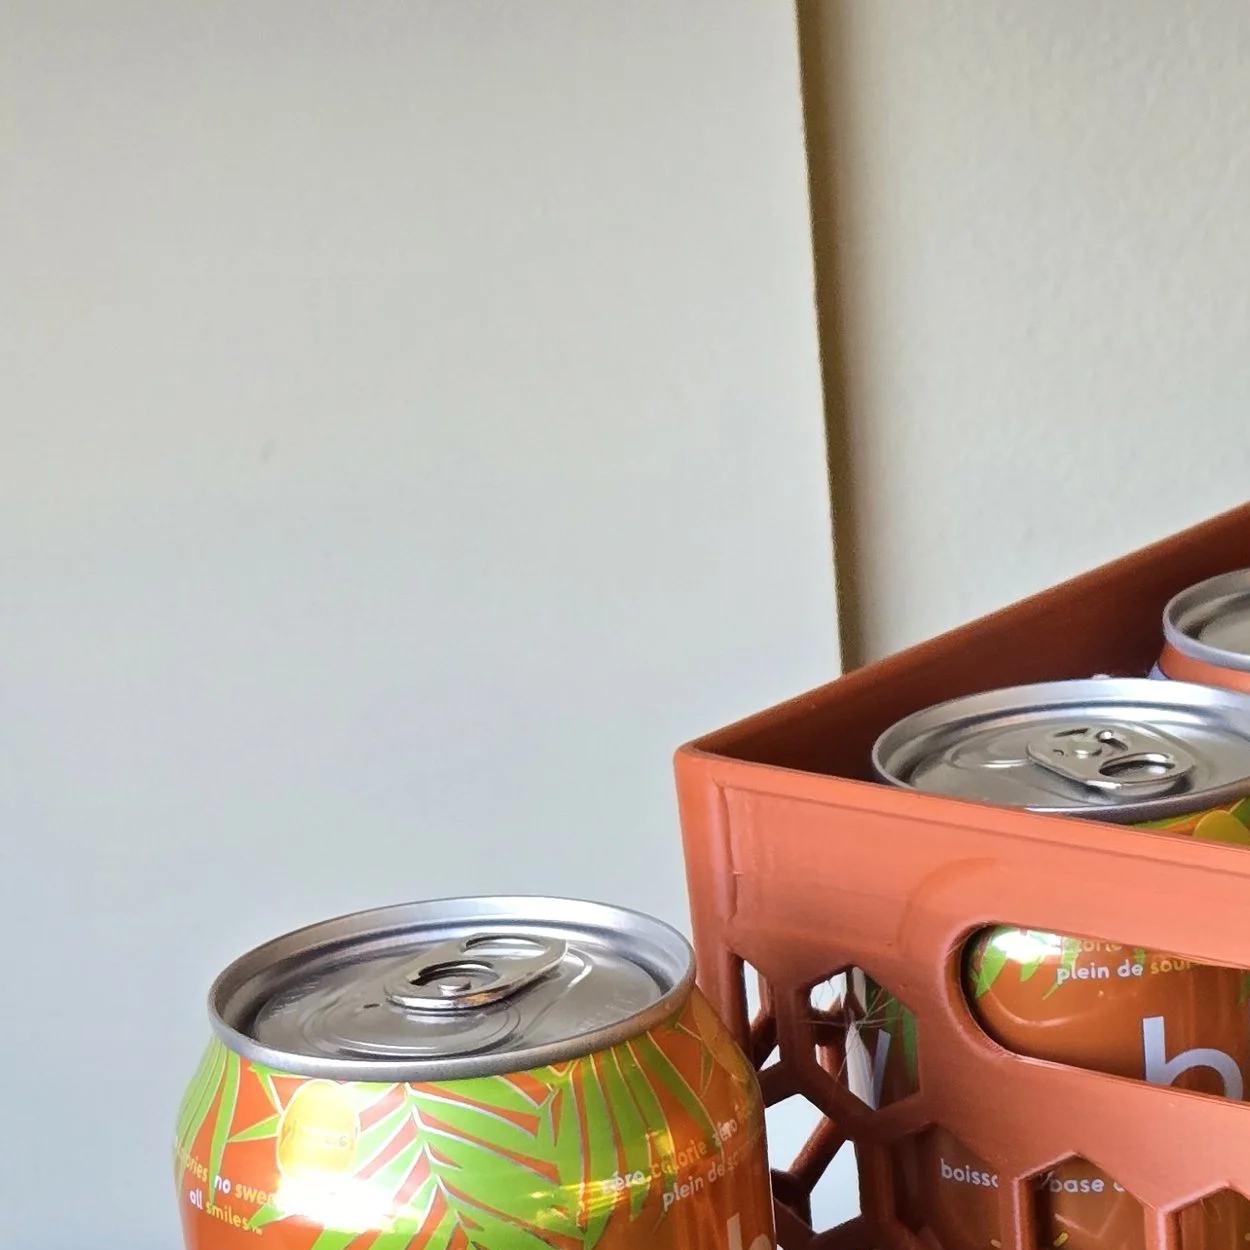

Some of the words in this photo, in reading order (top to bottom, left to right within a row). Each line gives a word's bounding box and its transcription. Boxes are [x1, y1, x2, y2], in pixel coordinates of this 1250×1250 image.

[1056, 961, 1110, 985] plein
[1117, 959, 1144, 978] de
[214, 1174, 232, 1195] no
[662, 1174, 705, 1212] plein
[189, 1187, 204, 1210] all
